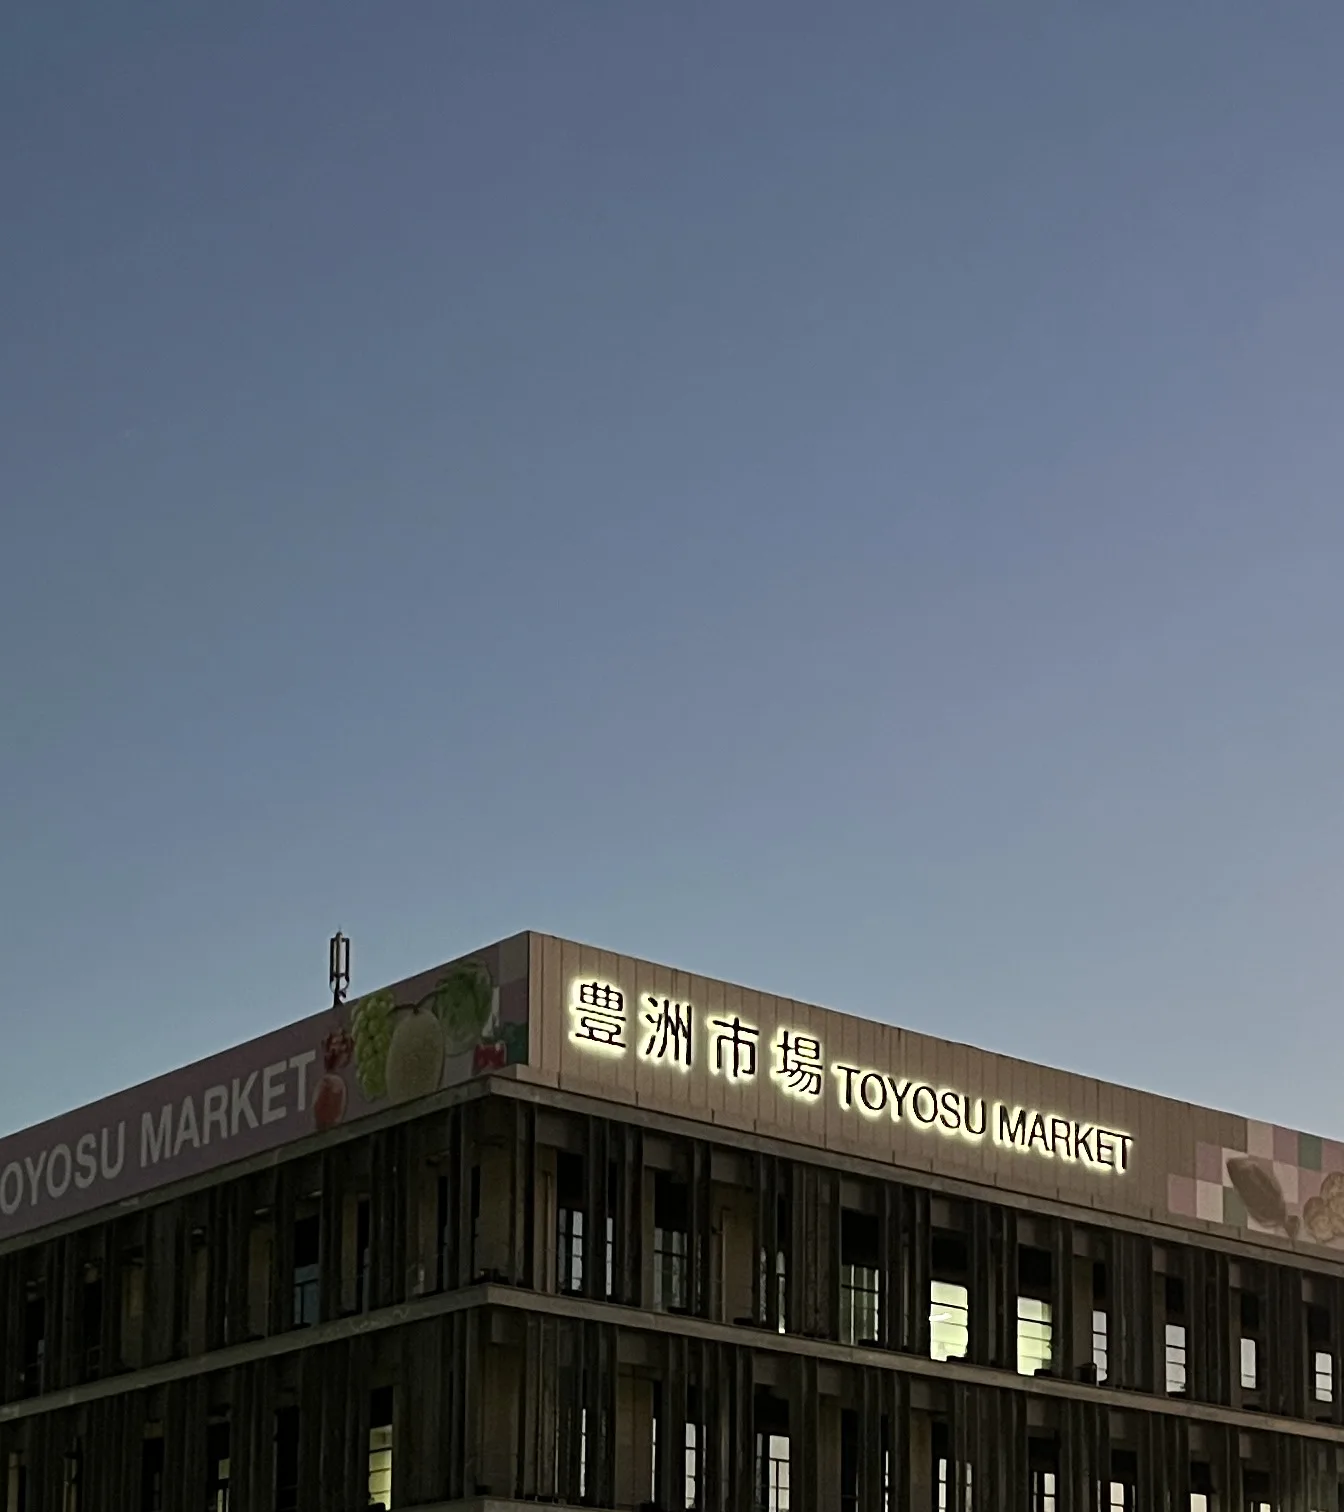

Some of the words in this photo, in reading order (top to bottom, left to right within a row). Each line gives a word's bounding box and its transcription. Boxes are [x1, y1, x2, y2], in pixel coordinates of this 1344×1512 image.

[574, 982, 823, 1096] 豊洲市場
[140, 1050, 316, 1168] MARKET
[837, 1064, 987, 1135] TOYOSU
[994, 1104, 1134, 1173] MARKET
